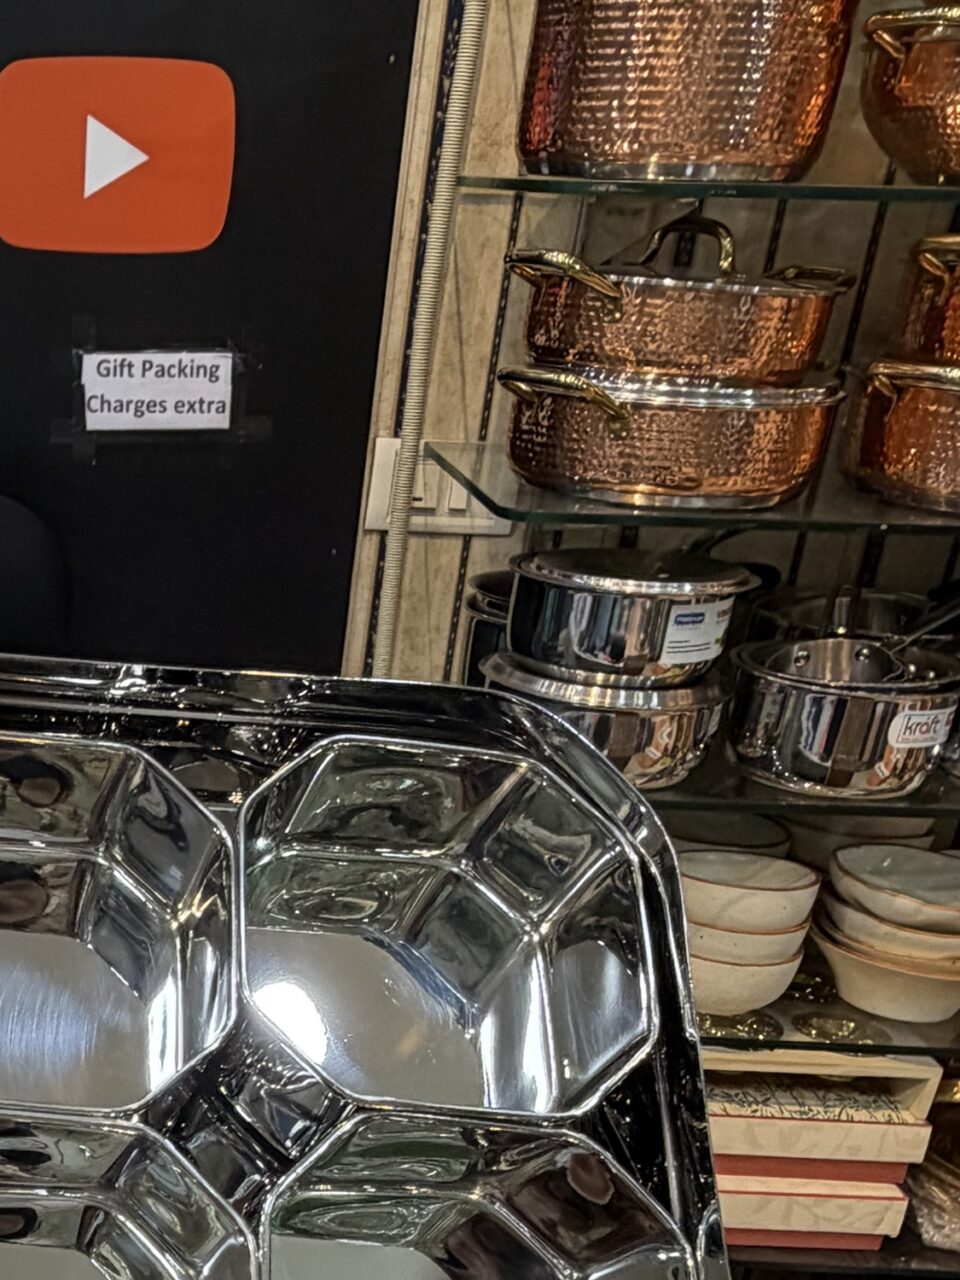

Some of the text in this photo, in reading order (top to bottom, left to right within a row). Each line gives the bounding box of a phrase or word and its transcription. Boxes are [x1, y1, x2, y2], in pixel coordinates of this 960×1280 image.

[96, 358, 221, 383] Gift Packing
[86, 393, 227, 418] Charges extra
